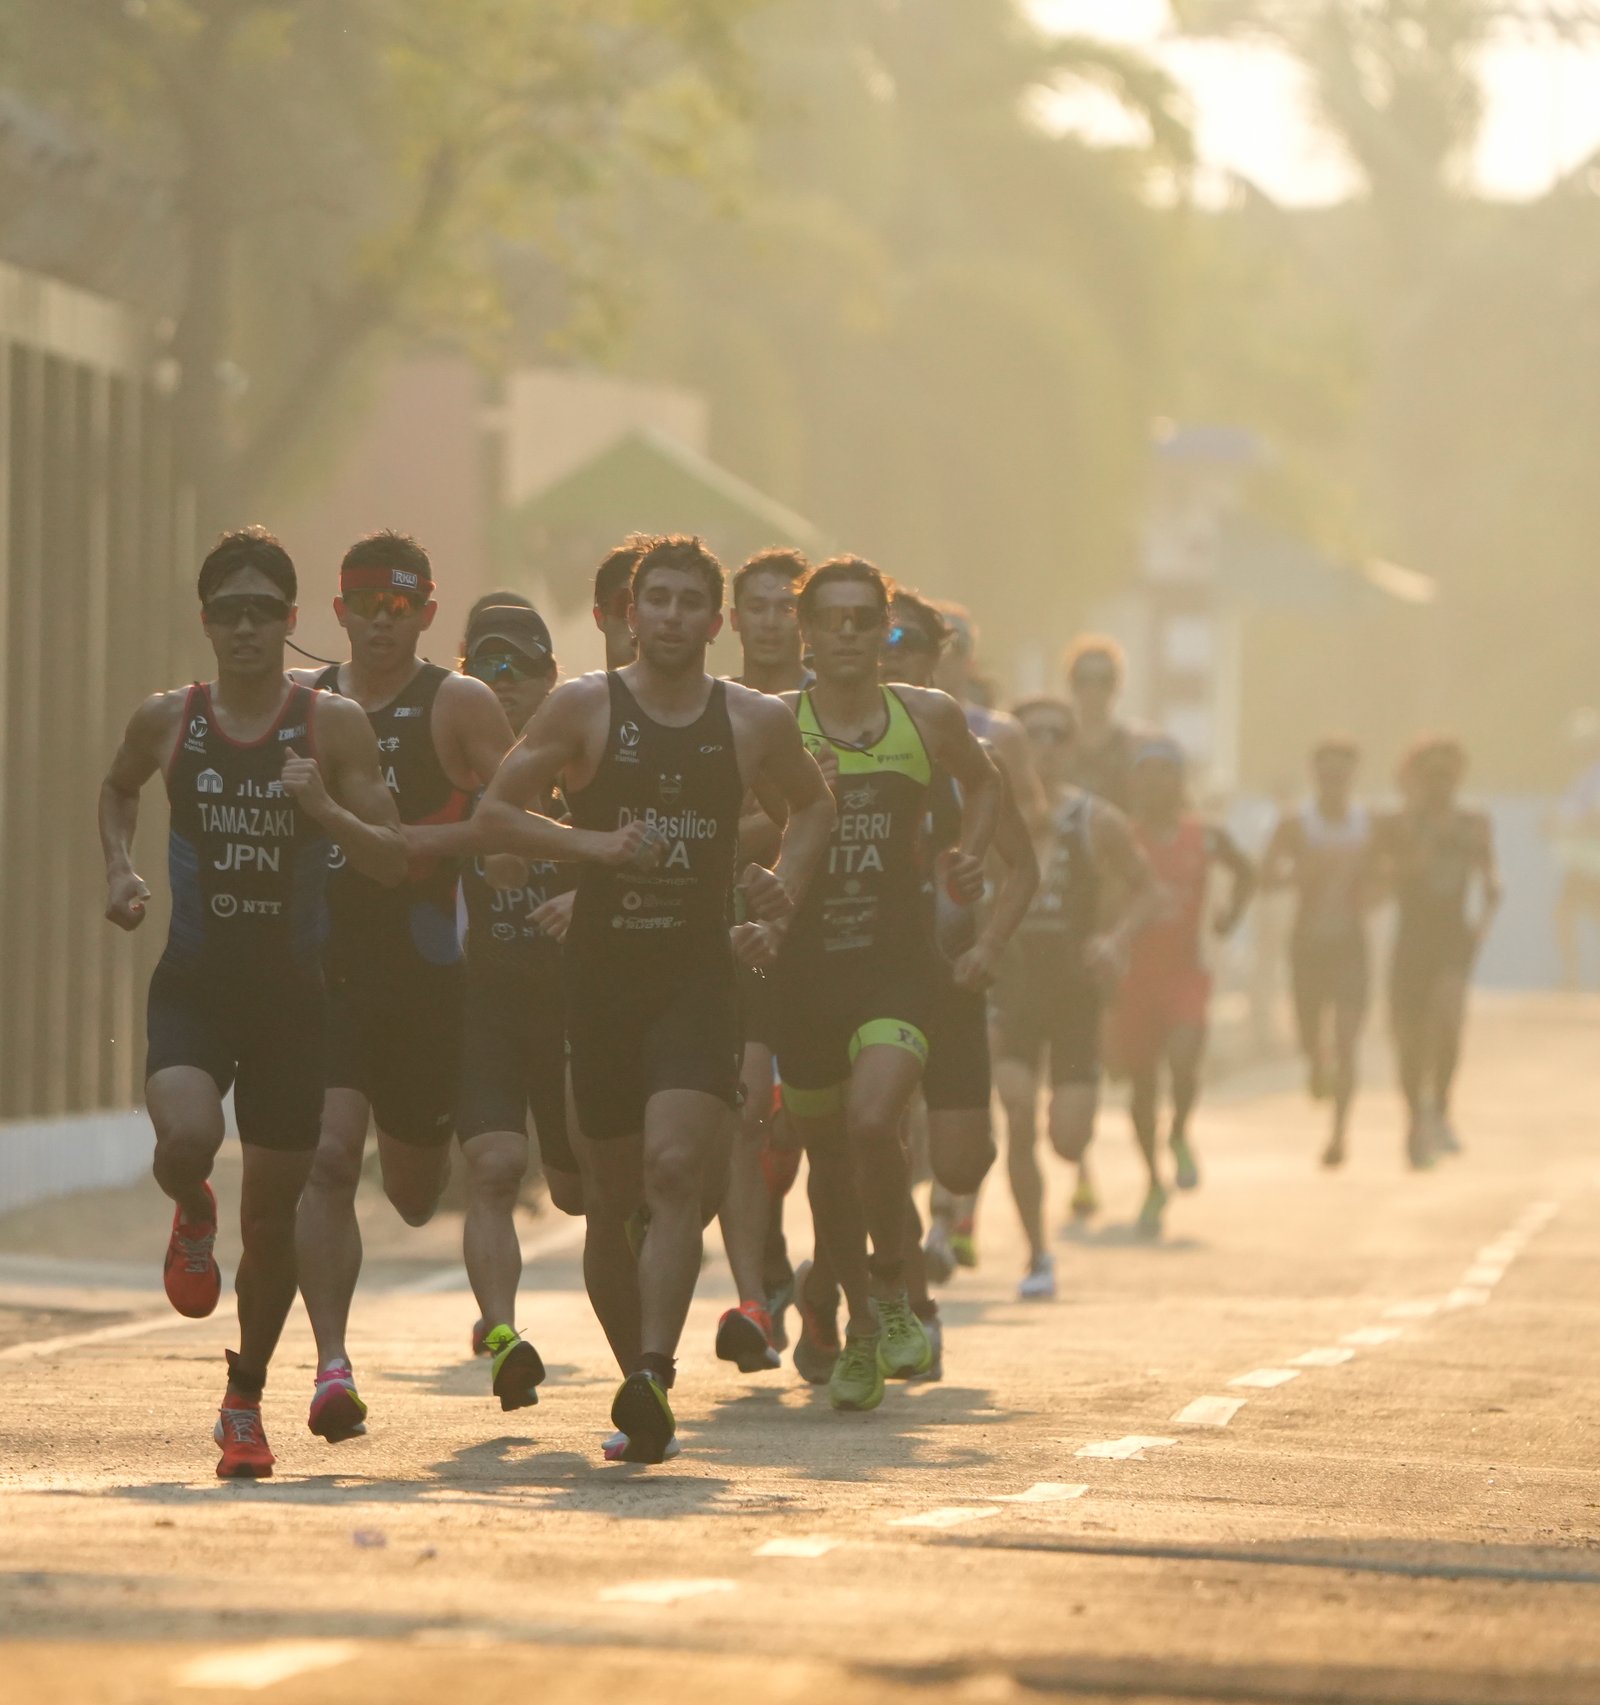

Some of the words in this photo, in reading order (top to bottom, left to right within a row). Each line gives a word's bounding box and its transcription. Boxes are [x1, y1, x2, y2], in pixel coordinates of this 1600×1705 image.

[394, 570, 416, 585] RKU
[198, 803, 294, 837] TAMAZAKI
[645, 807, 718, 839] Basilico
[213, 843, 280, 872] JPN
[828, 843, 885, 874] ITA
[242, 900, 282, 915] NTT
[490, 886, 547, 913] JPN
